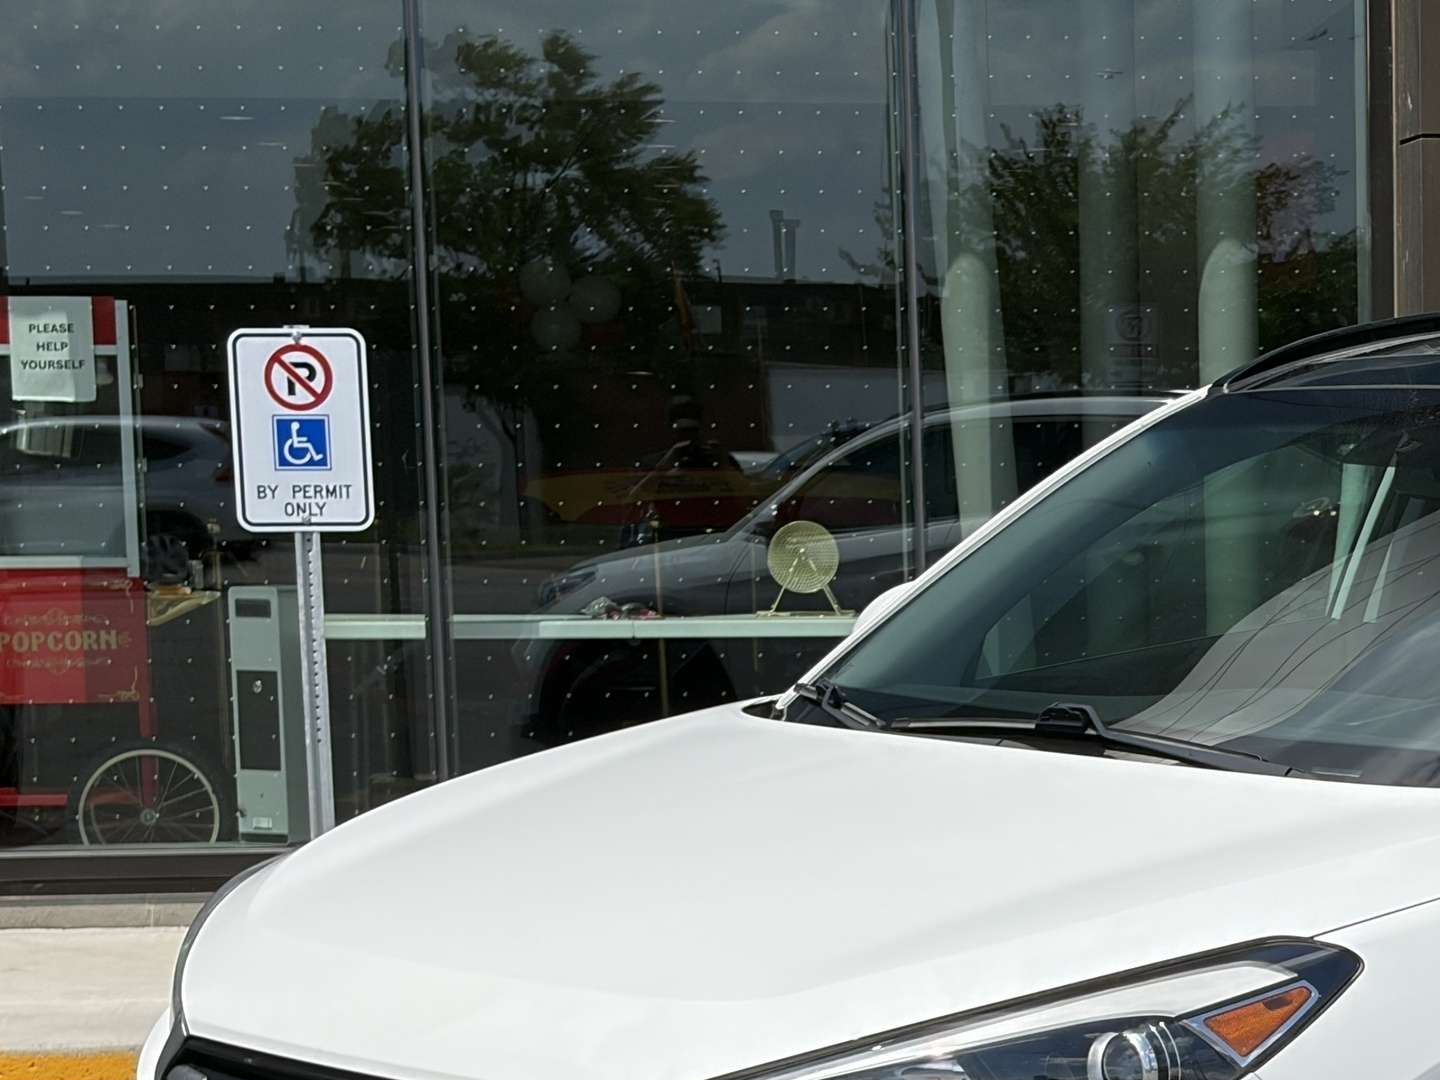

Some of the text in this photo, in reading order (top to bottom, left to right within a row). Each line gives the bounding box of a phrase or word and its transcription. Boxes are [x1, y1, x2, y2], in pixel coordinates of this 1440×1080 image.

[28, 322, 75, 334] PLEASE
[36, 341, 69, 352] HELP
[20, 359, 86, 370] YOURSELF
[257, 484, 352, 500] BY PERMIT
[284, 502, 327, 517] ONLY
[0, 630, 118, 652] POPCORN
